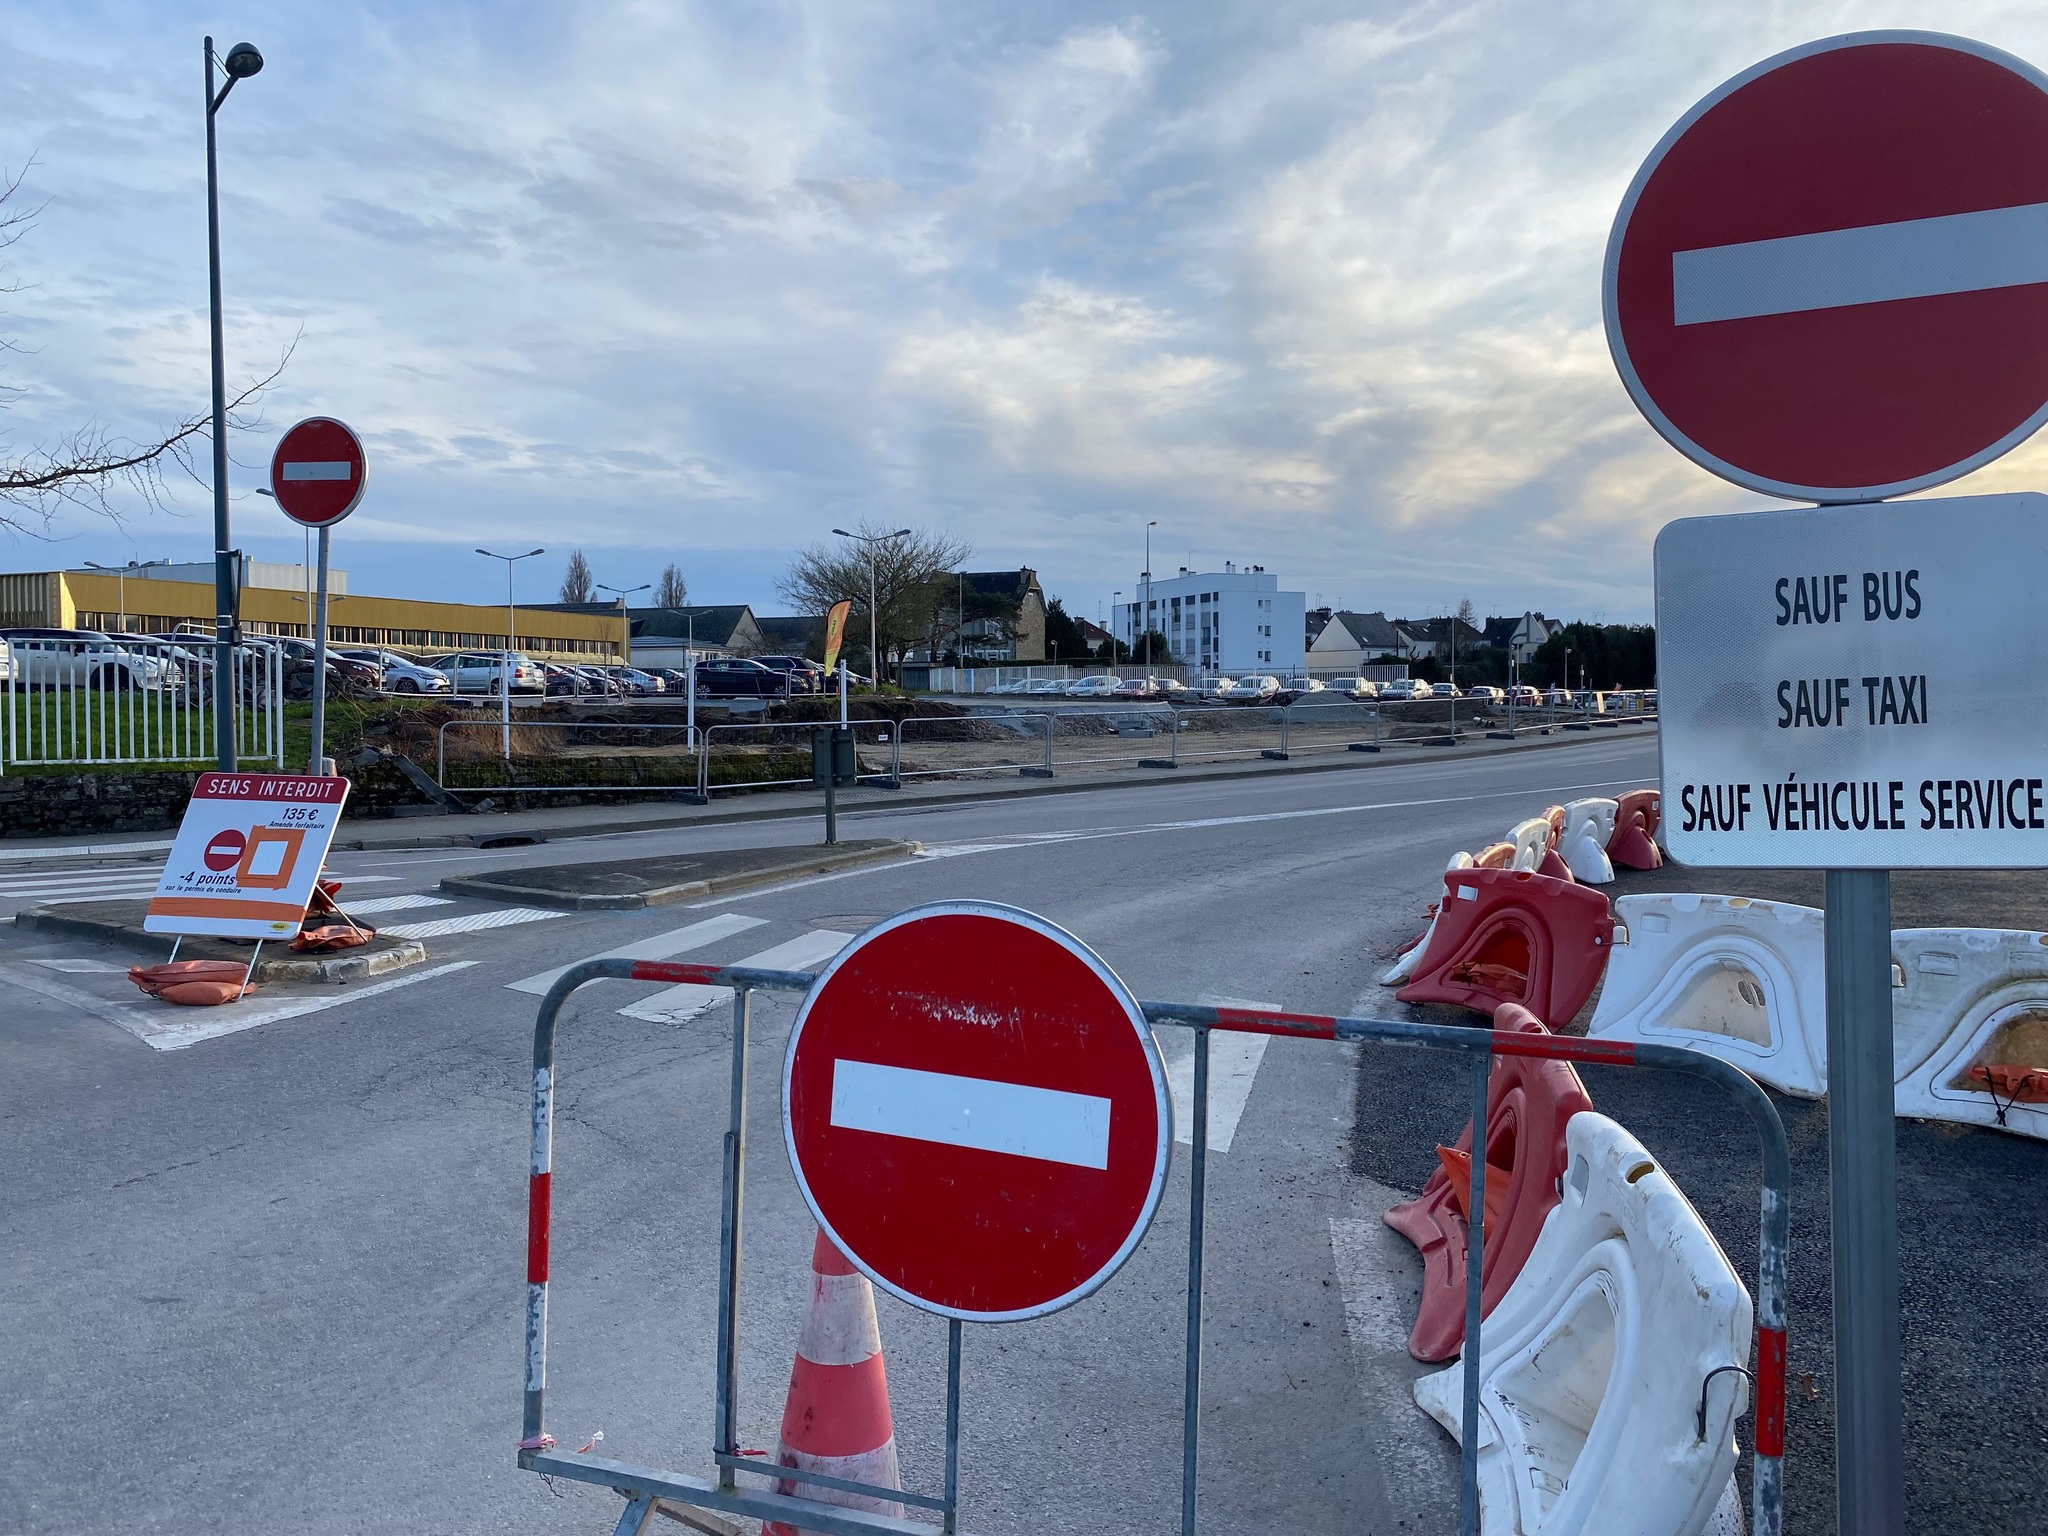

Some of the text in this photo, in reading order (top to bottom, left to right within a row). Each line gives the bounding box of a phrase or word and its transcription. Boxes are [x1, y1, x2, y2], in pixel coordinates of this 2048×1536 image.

[1775, 569, 1922, 626] SAUF BUS
[1777, 675, 1928, 729] SAUF TAXI
[208, 779, 334, 798] SENS INTERDIT
[1681, 772, 2045, 833] SAUF VÉHICULE SERVICE
[282, 808, 319, 820] 135 €
[294, 821, 325, 829] forfaitaire
[179, 871, 236, 887] -4 points
